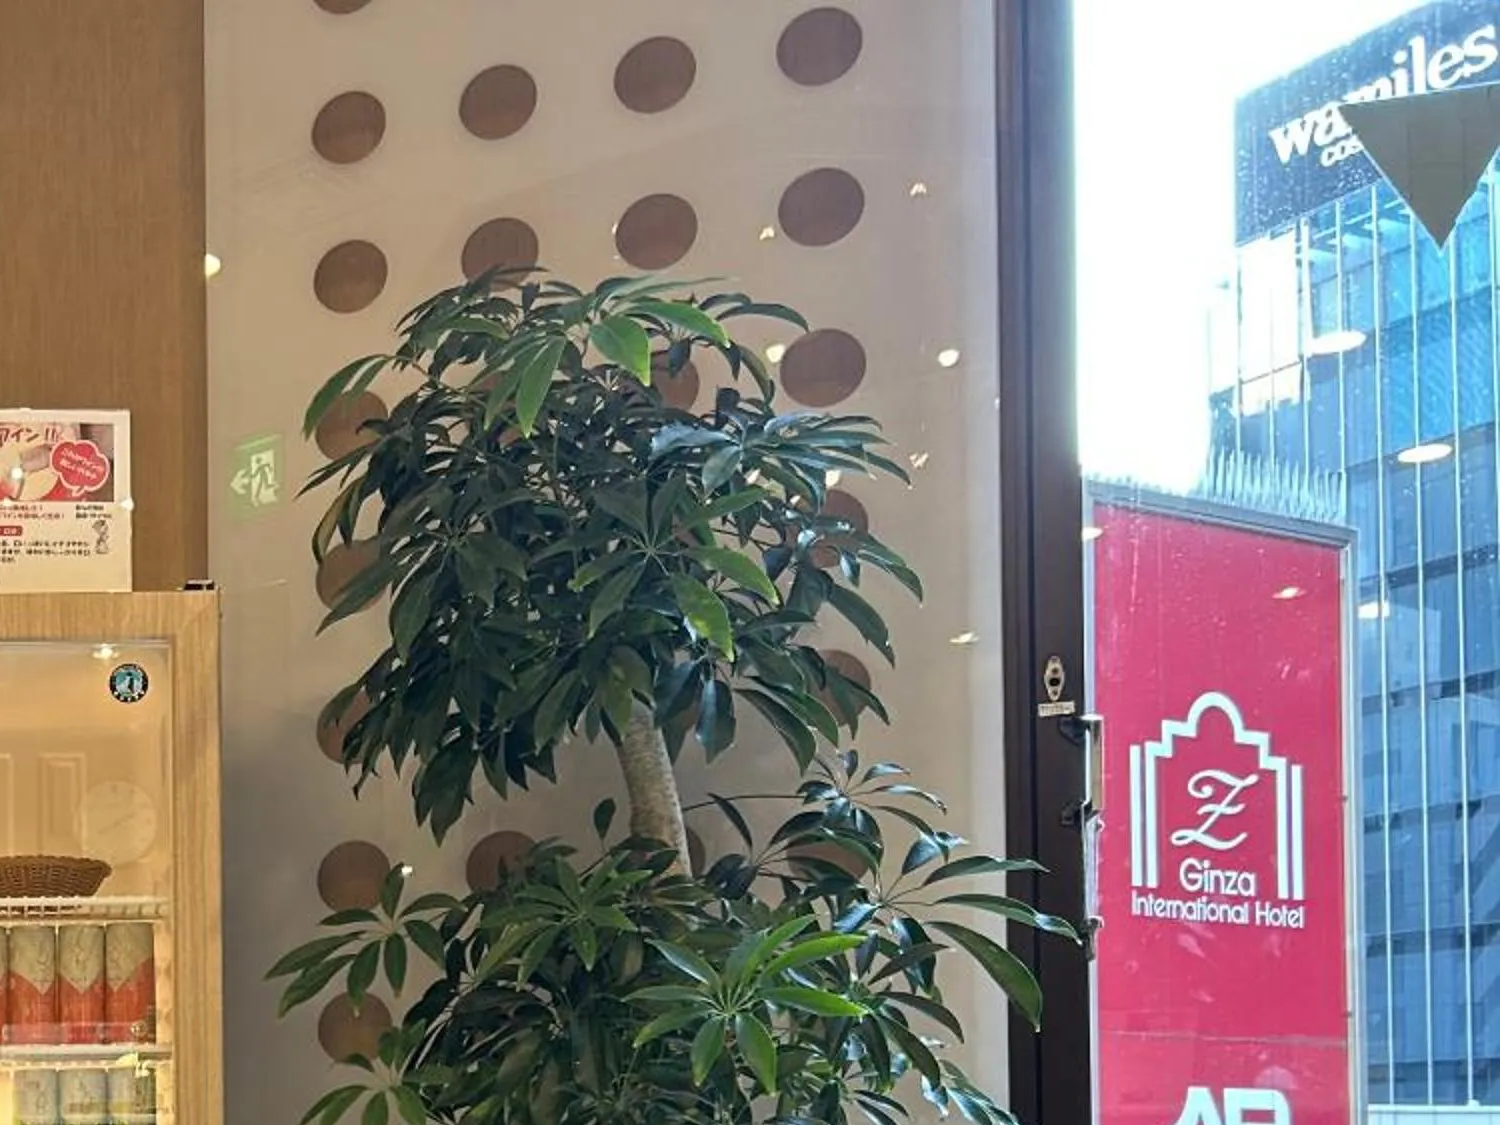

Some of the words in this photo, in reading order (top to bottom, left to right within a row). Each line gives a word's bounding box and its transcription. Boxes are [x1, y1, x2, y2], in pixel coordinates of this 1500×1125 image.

[1178, 856, 1257, 897] Ginza
[1130, 889, 1250, 926] International
[1253, 900, 1305, 930] Hotel
